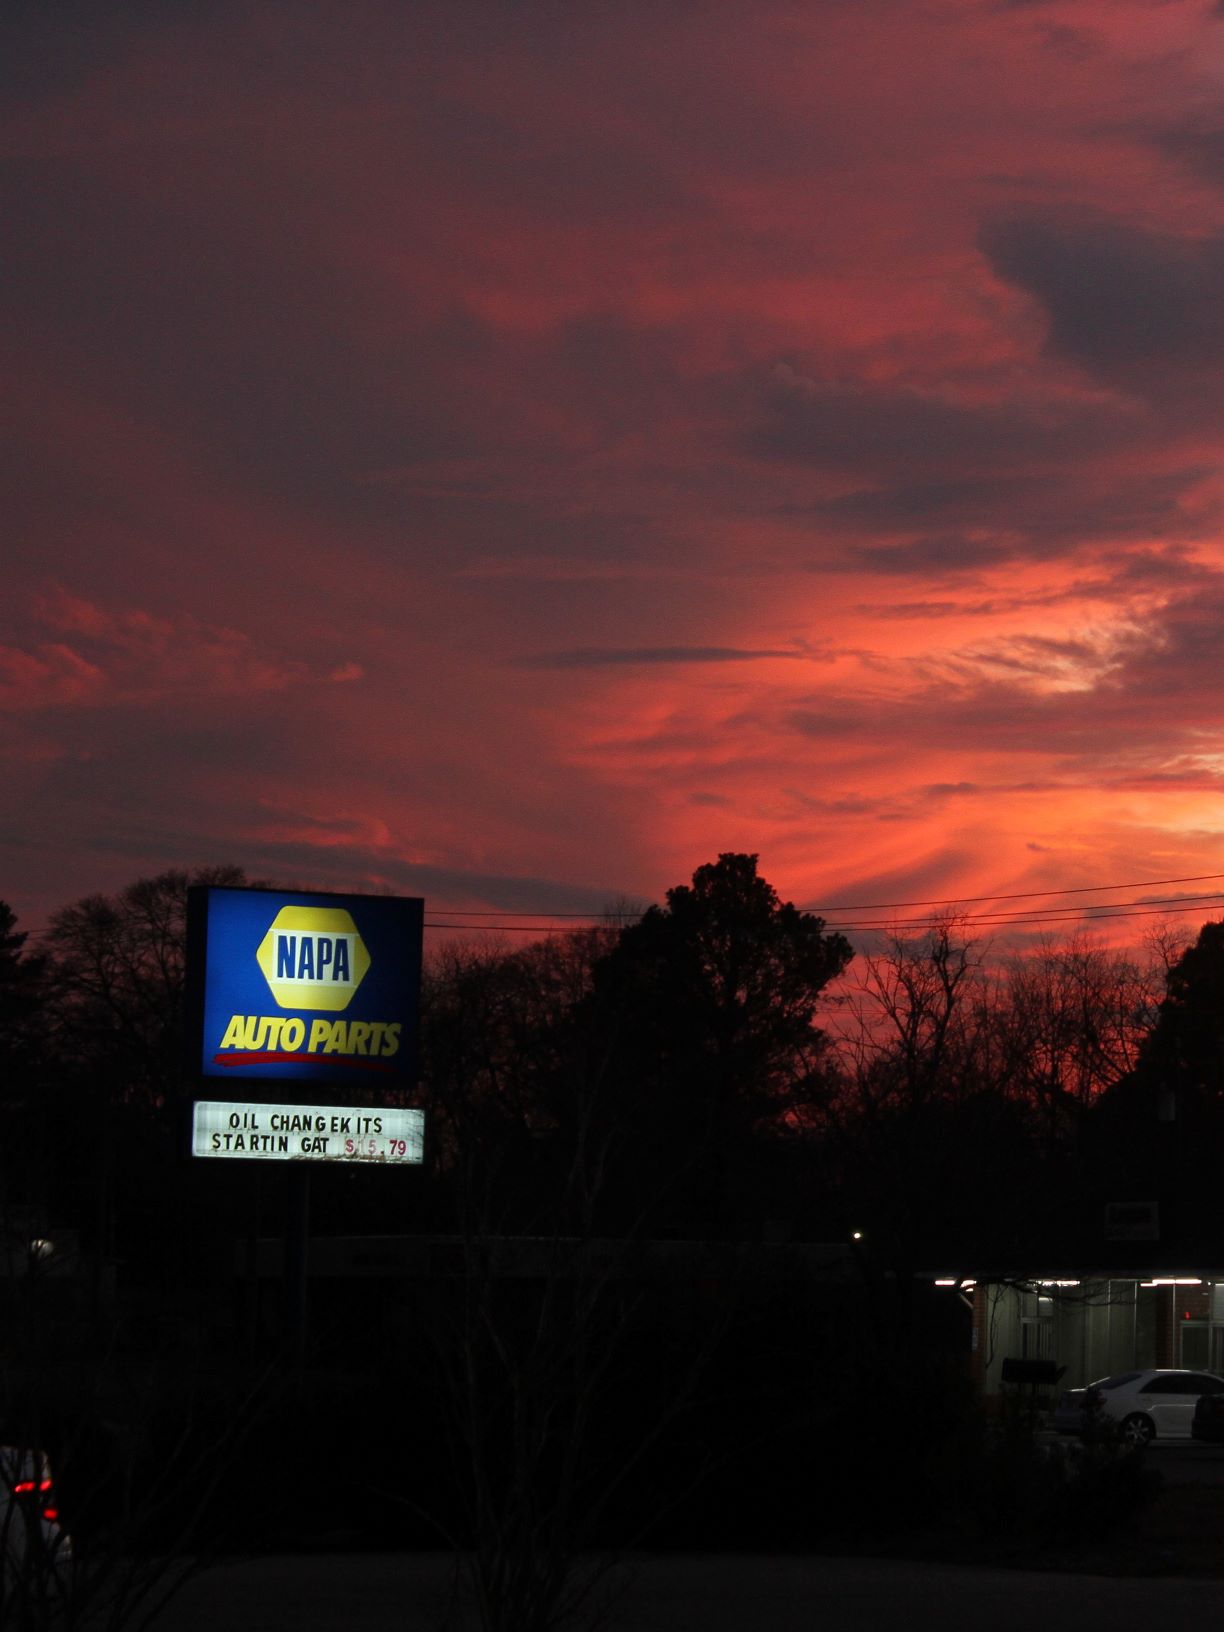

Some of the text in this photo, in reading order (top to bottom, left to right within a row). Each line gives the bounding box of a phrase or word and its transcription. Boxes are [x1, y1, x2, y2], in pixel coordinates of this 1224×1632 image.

[277, 935, 350, 982] NAPA
[219, 1014, 401, 1056] AUTO PARTS
[229, 1112, 259, 1130] OIL
